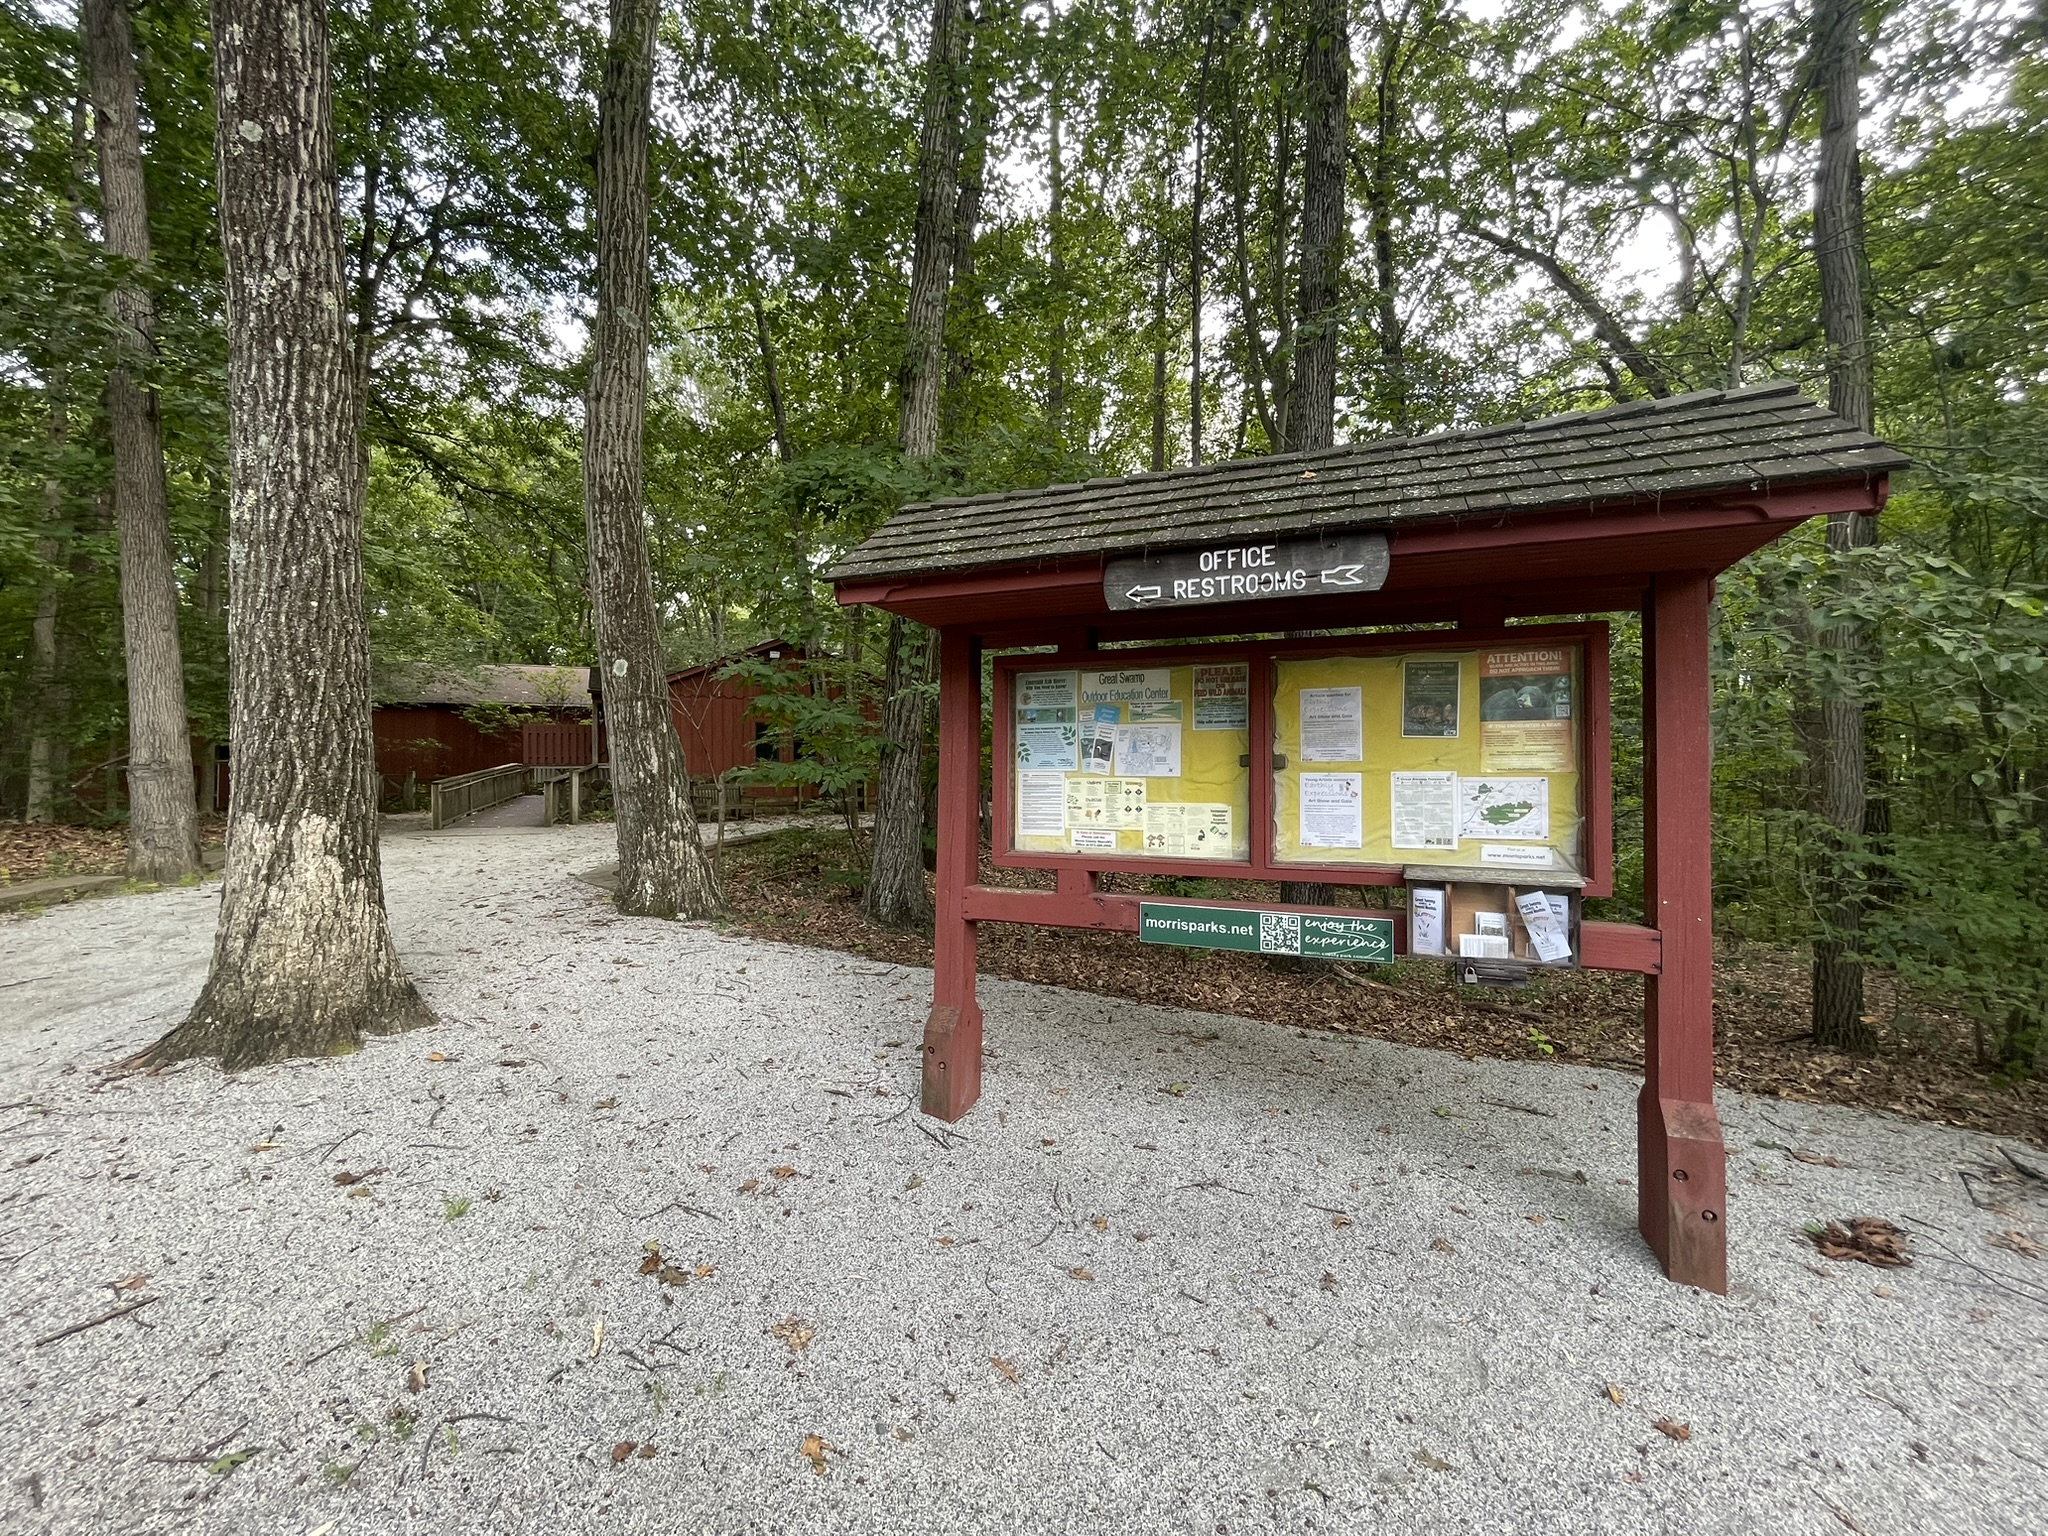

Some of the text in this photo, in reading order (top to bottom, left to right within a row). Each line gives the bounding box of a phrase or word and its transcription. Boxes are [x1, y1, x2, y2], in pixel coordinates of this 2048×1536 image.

[1199, 545, 1276, 572] OFFICE
[1173, 568, 1307, 599] RESTROOMS
[1486, 650, 1562, 664] ATTENTION!
[1200, 665, 1241, 677] PLEASE
[1099, 672, 1146, 685] Great Swamp
[1081, 690, 1109, 703] Outdoor
[1109, 688, 1143, 701] Education
[1144, 687, 1169, 700] Center
[1208, 688, 1222, 697] WILD
[1222, 687, 1247, 696] ANIMALS
[1304, 782, 1334, 791] Earthly
[1304, 790, 1349, 799] Expressions
[1145, 918, 1254, 936] morrisparks.net
[1304, 917, 1377, 932] enjoy the
[1304, 934, 1390, 949] experience
